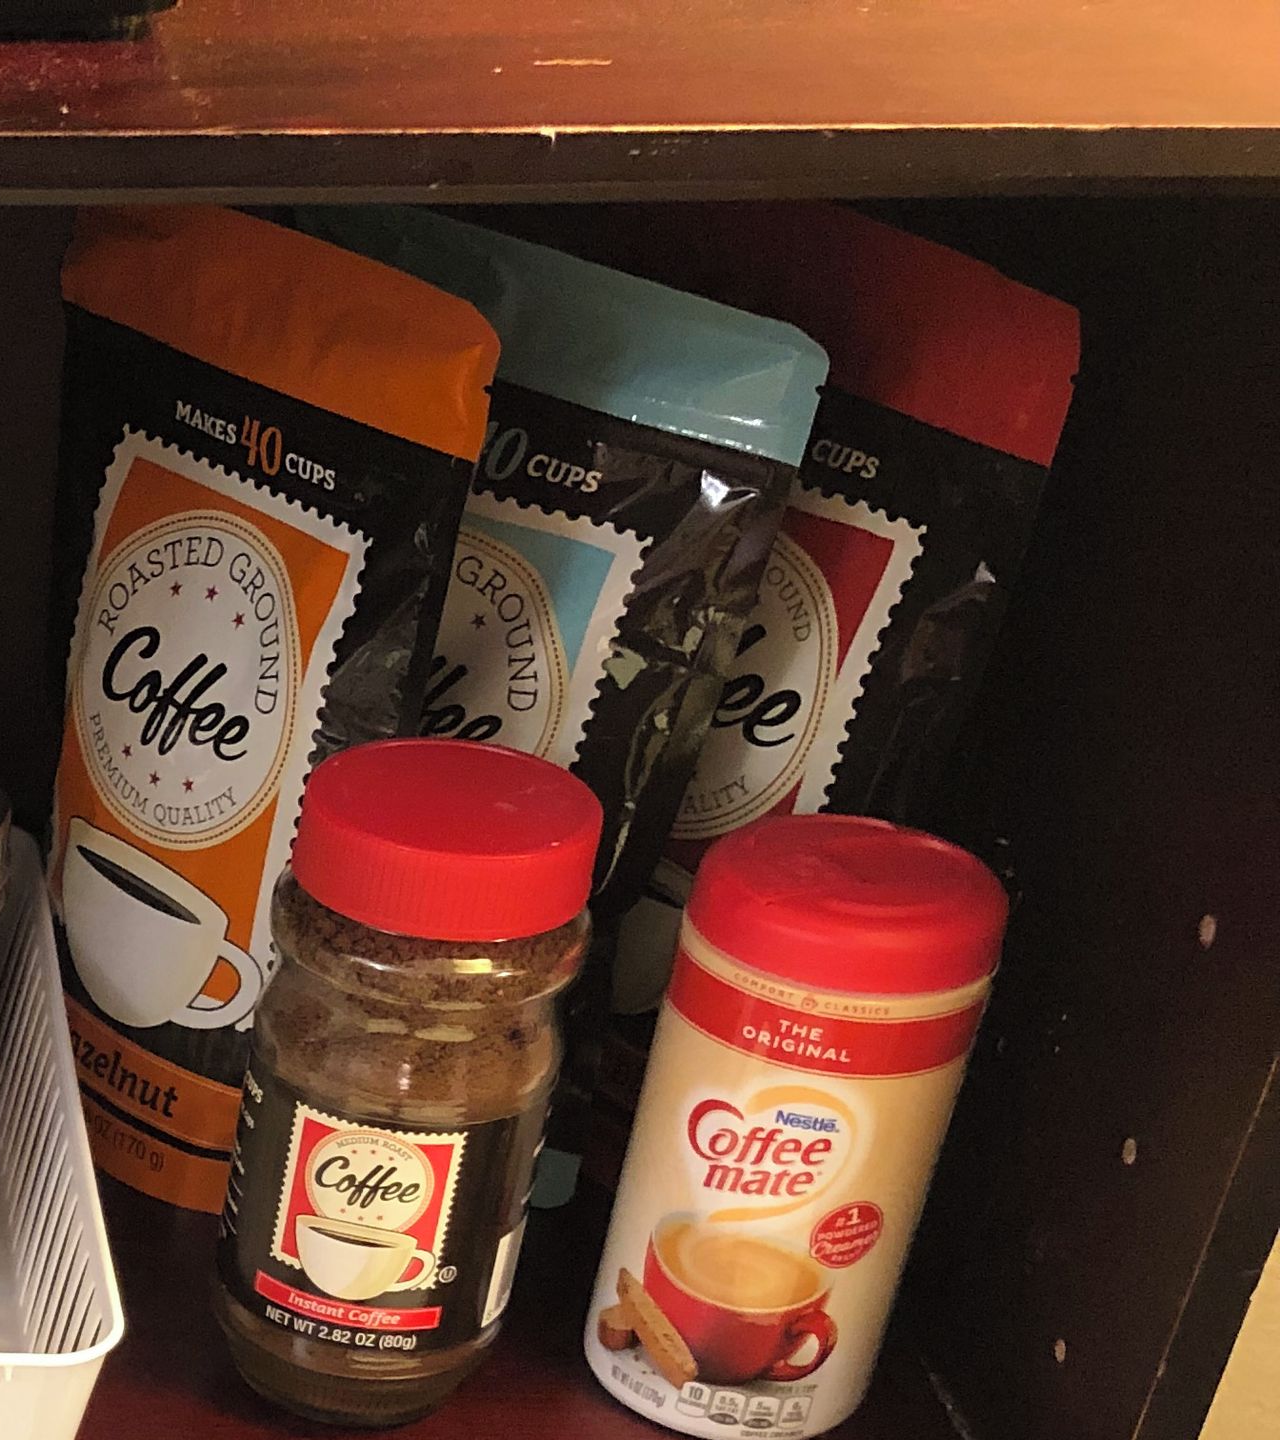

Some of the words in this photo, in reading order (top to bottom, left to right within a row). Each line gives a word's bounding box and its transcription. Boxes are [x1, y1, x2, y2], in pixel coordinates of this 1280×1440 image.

[175, 400, 237, 444] MAKES
[241, 415, 282, 476] 40
[286, 452, 336, 491] CUPS
[811, 439, 880, 480] CUPS
[527, 454, 603, 493] CUPS
[97, 536, 225, 636] ROASTED
[229, 552, 280, 715] GROUND
[766, 565, 812, 644] OUND
[455, 555, 539, 713] GROUND
[102, 626, 251, 762] Coffee
[90, 713, 148, 815] PREMIUM
[152, 787, 238, 827] QUALITY
[779, 1019, 824, 1042] THE
[823, 1002, 891, 1016] CLASSICS
[742, 1025, 852, 1063] ORIGINAL
[70, 1030, 179, 1119] azelnut
[335, 1137, 380, 1149] MEDIUM
[382, 1139, 414, 1162] ROAST
[687, 1099, 833, 1167] Coffee
[314, 1155, 421, 1209] Coffee
[703, 1164, 815, 1197] mate
[265, 1304, 290, 1327] NET
[293, 1317, 316, 1336] WT
[318, 1325, 350, 1343] 2.82
[354, 1332, 375, 1348] OZ
[379, 1333, 417, 1350] (80g)
[288, 1292, 345, 1319] Instant
[348, 1309, 402, 1329] Coffee
[689, 1386, 704, 1400] 10
